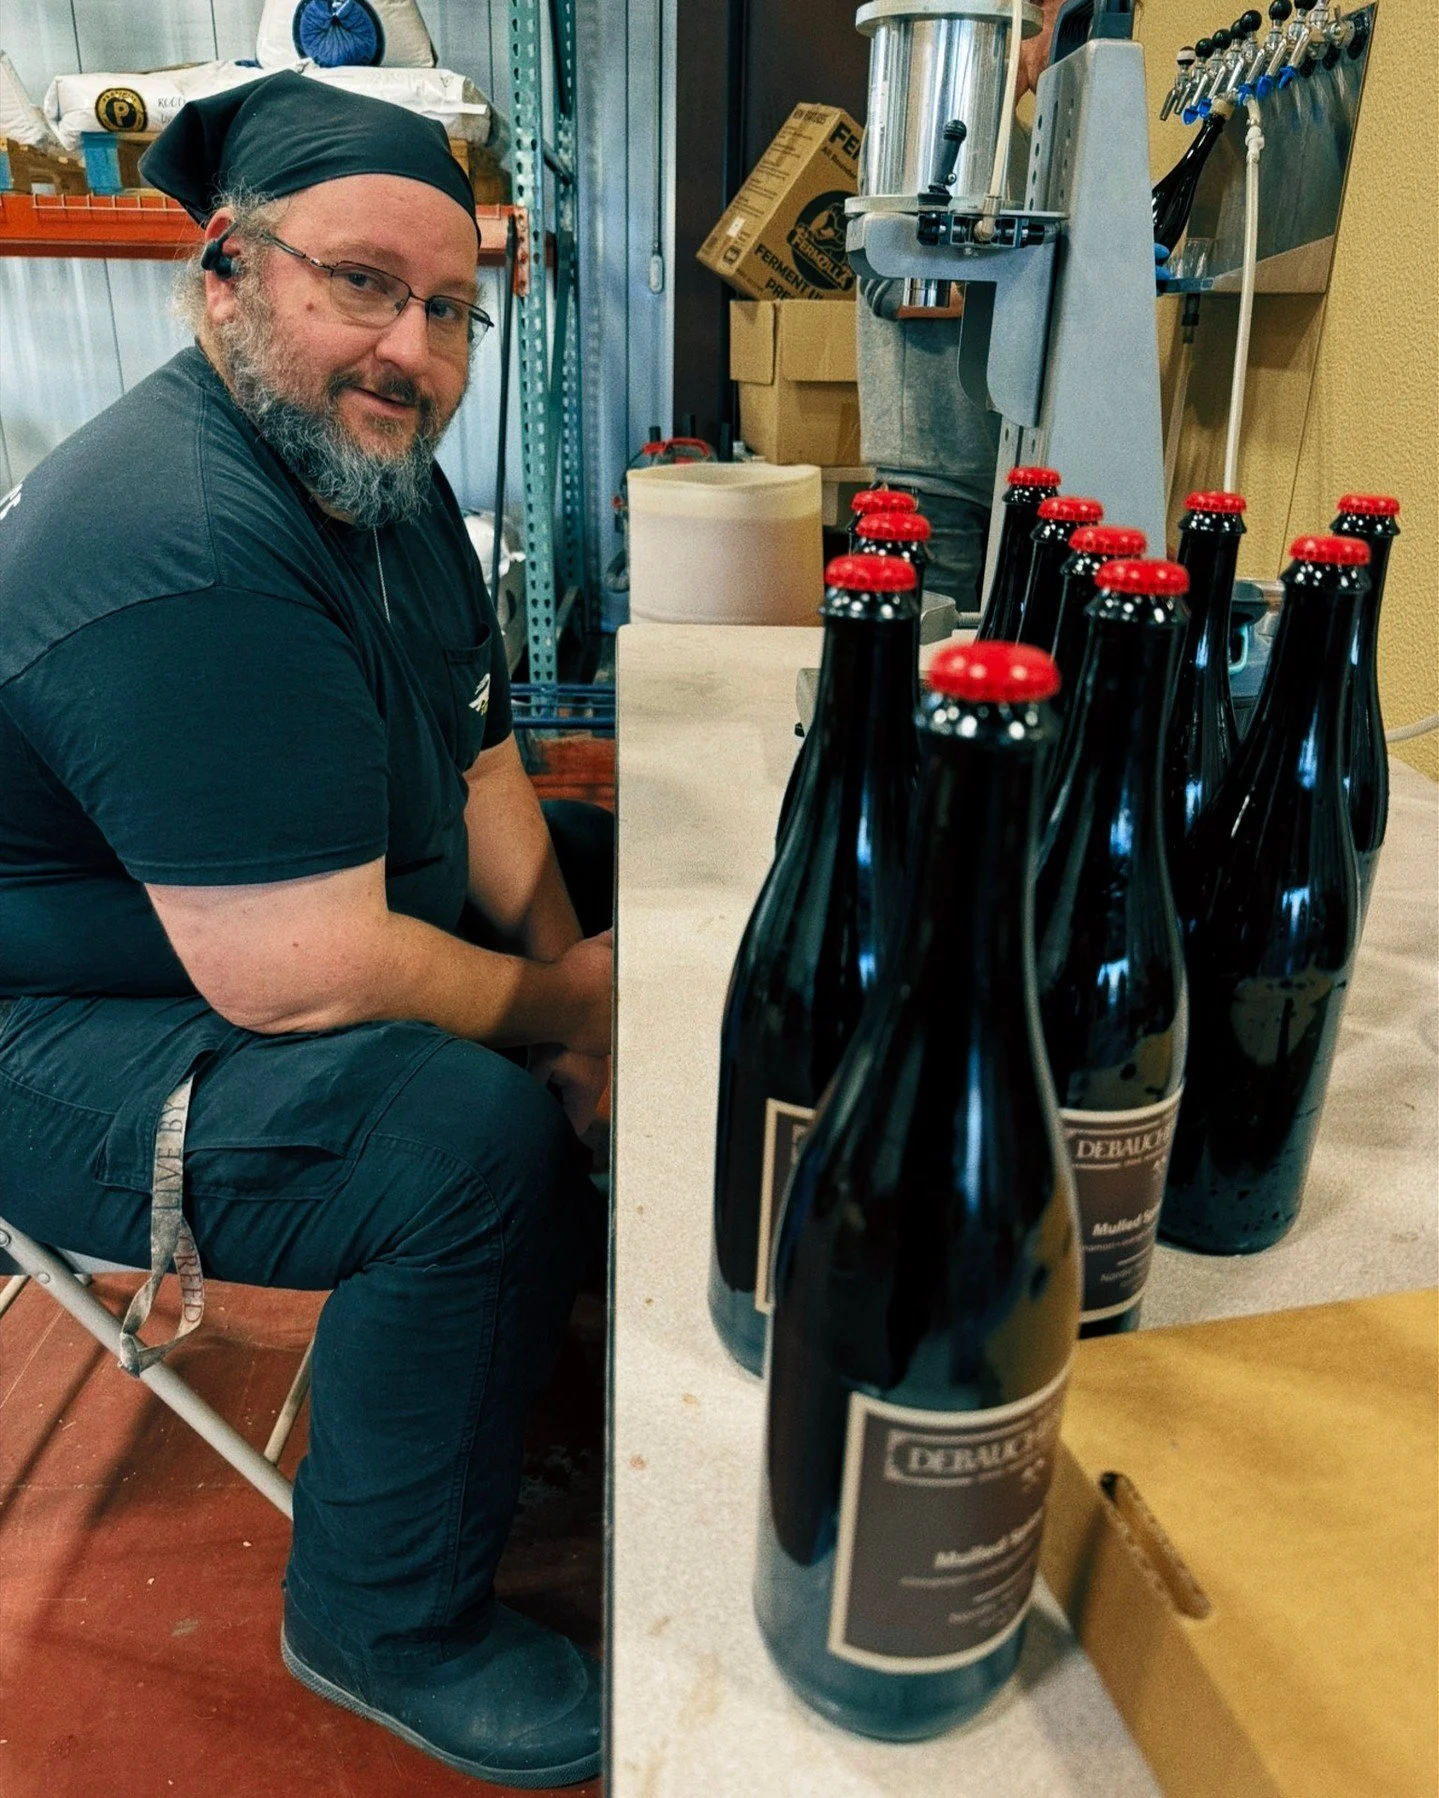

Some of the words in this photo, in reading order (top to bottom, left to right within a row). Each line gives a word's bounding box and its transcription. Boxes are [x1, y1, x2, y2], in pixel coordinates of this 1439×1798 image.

[754, 243, 809, 293] FERMENT
[791, 234, 852, 288] FERMZILLA
[765, 278, 795, 300] PRE
[160, 1102, 185, 1132] BY
[155, 1147, 182, 1209] LIVE
[1092, 1213, 1142, 1237] Mulled
[176, 1236, 203, 1323] CREED
